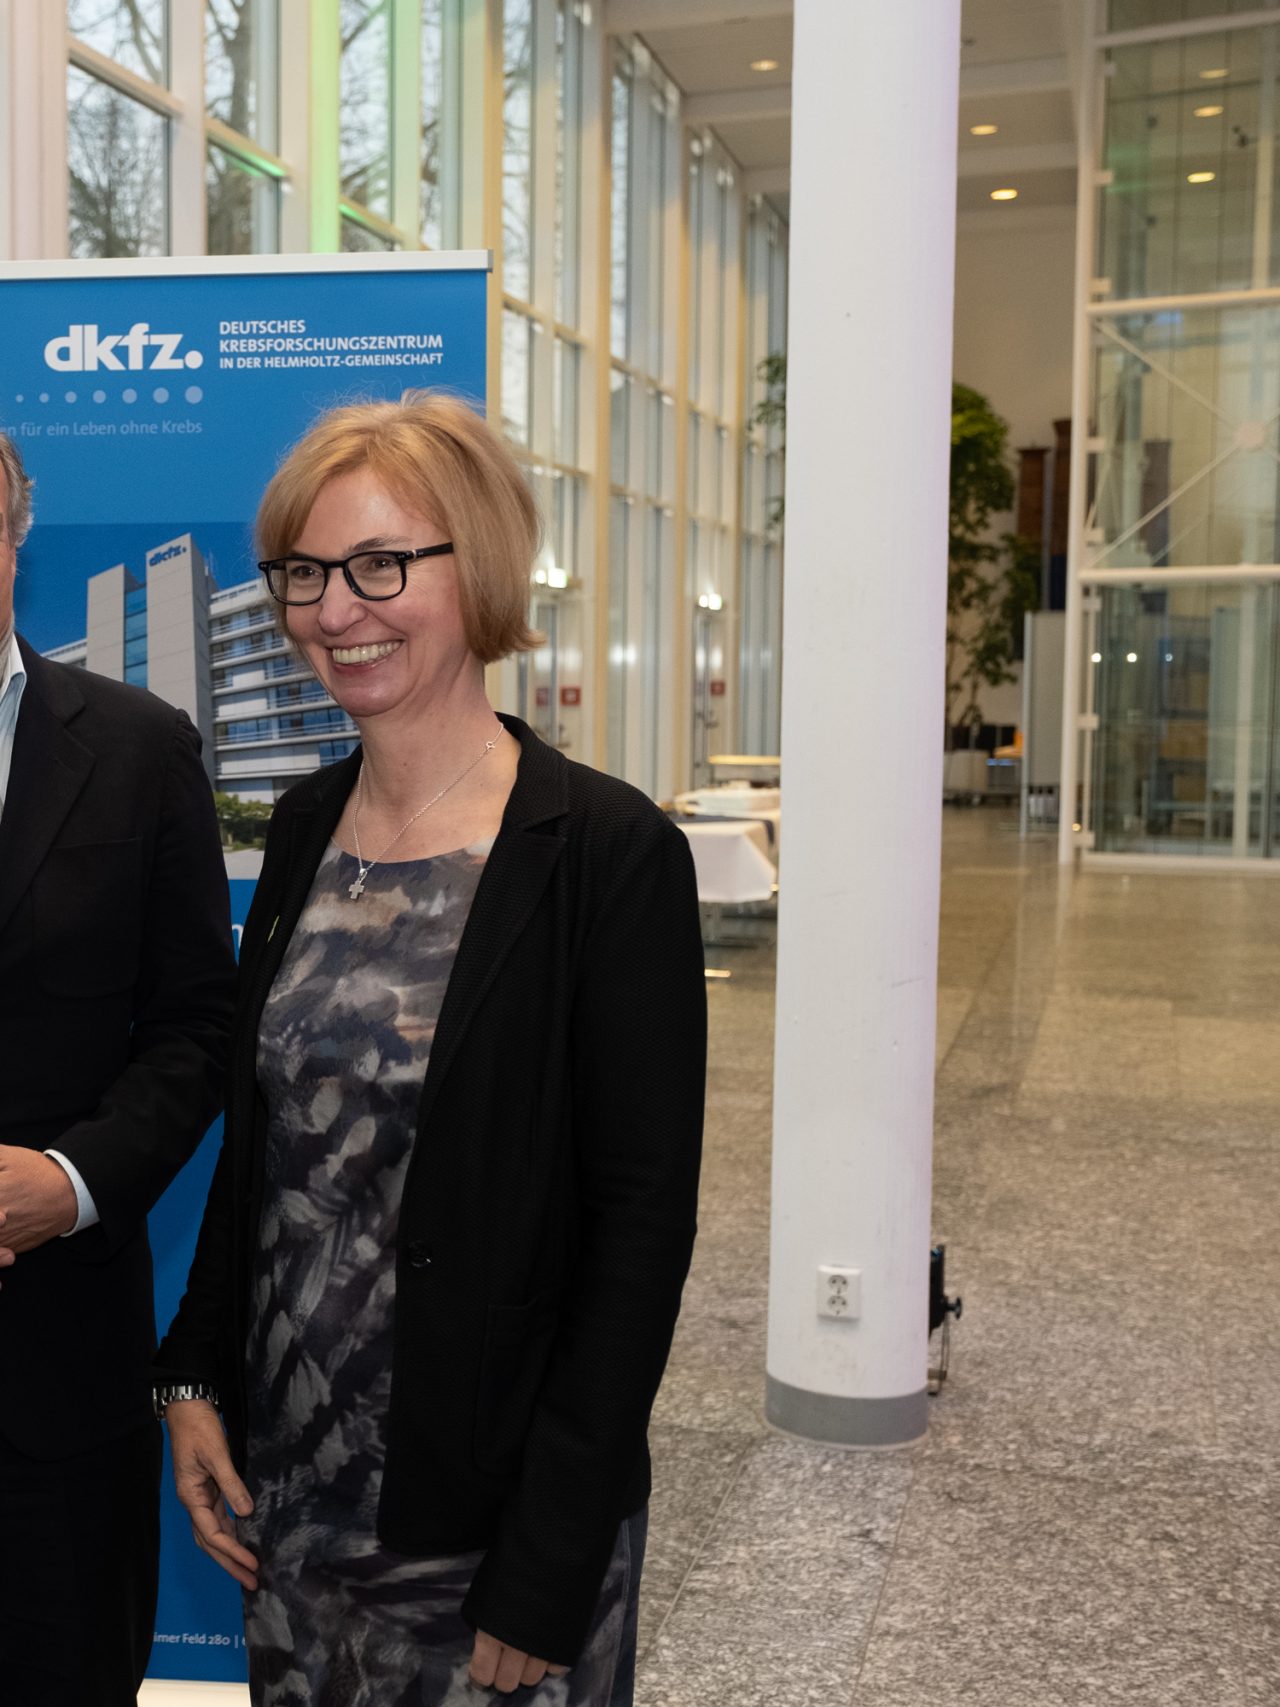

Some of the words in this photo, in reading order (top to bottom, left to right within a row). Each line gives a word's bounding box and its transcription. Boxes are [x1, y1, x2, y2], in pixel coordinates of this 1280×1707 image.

[220, 320, 306, 335] DEUTSCHES
[44, 322, 204, 372] dkfz.
[220, 335, 443, 353] KREBSFORSCHUNGSZENTRUM
[220, 357, 234, 369] IN
[237, 356, 261, 369] DER
[264, 353, 443, 369] HELMHOLTZ-GEMEINSCHAFT
[21, 422, 42, 436] für
[46, 422, 69, 436] ein
[73, 421, 116, 435] Leben
[120, 420, 158, 435] ohne
[162, 419, 203, 434] Krebs
[182, 1633, 206, 1645] Feld
[208, 1634, 231, 1645] 280
